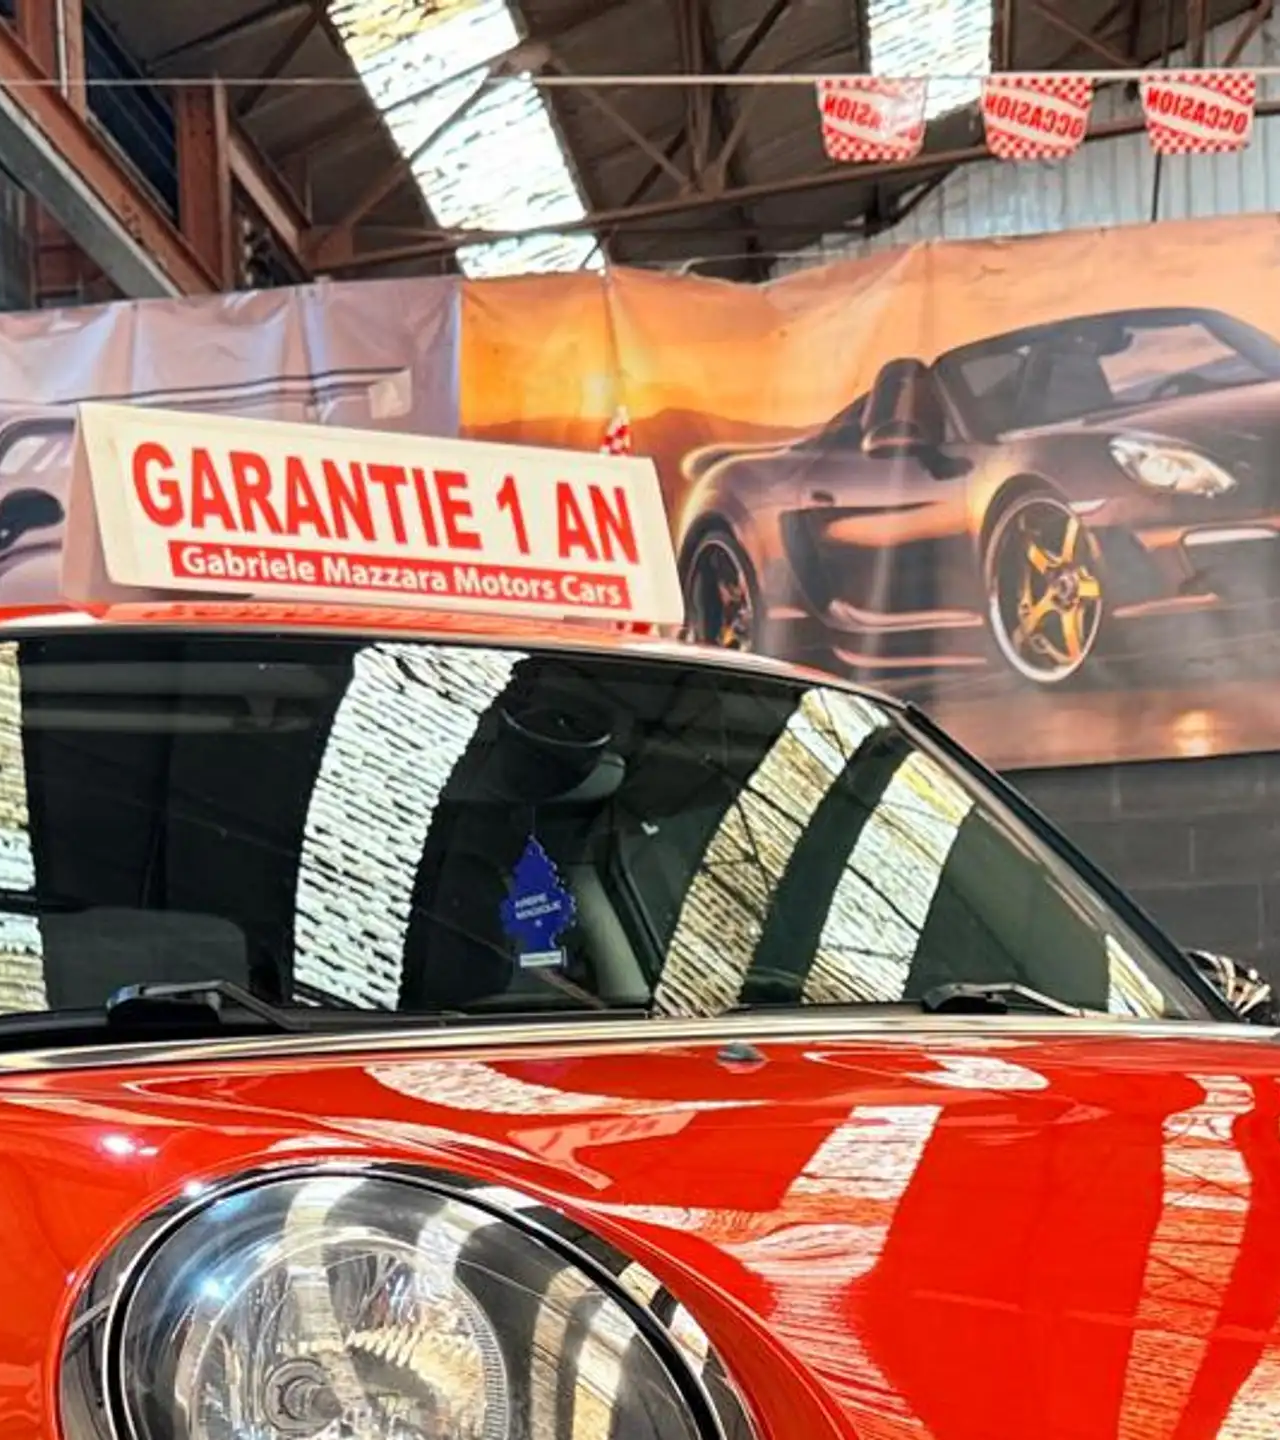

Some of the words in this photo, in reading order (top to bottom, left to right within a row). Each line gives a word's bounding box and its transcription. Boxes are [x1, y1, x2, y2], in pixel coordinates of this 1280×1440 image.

[131, 441, 483, 550] GARANTIE
[496, 474, 531, 555] 1
[556, 480, 641, 565] AN
[181, 545, 317, 583] Gabriele
[323, 556, 448, 593] Mazzara
[453, 567, 556, 602] Motors
[560, 574, 622, 606] Cars
